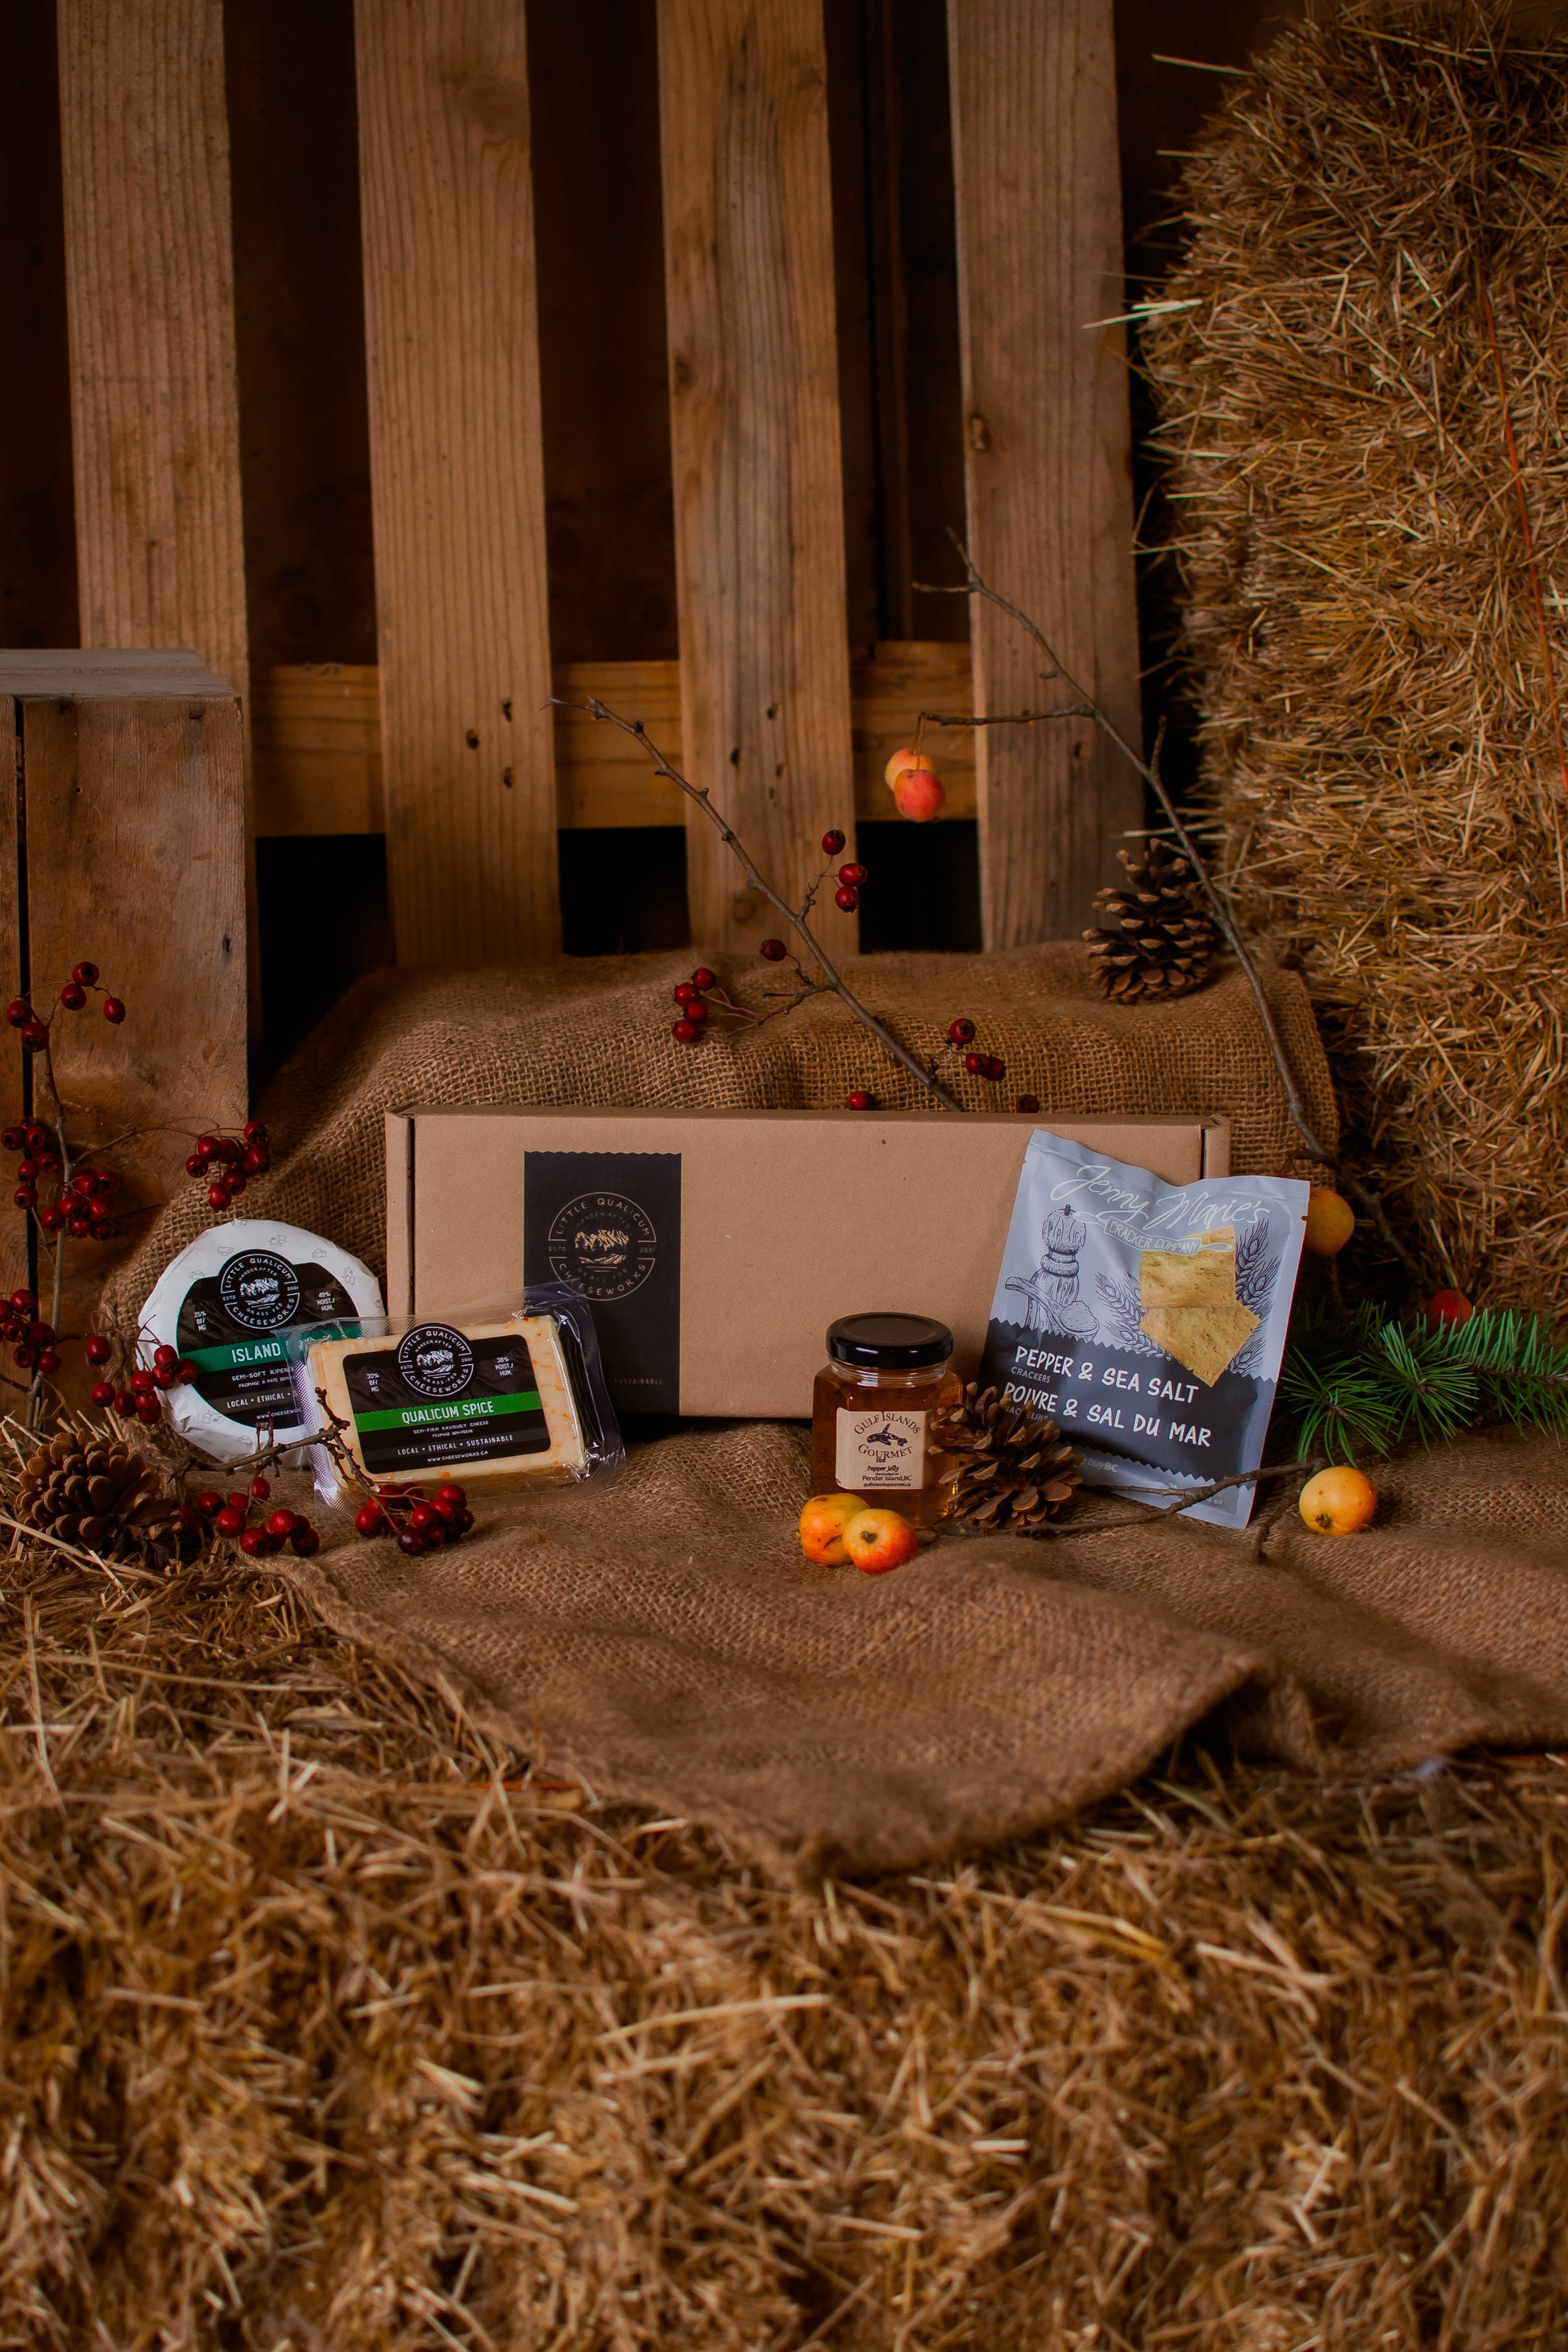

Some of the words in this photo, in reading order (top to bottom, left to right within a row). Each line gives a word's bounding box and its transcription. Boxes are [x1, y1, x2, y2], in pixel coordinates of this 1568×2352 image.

[1050, 1164, 1149, 1223] Jenny
[1143, 1192, 1271, 1231] Marie's
[555, 1201, 587, 1235] LITTLE
[597, 1197, 650, 1235] QUALICUM
[1108, 1222, 1152, 1249] CRACKER
[1155, 1238, 1199, 1254] COMPANY
[225, 1262, 245, 1288] LITTLE
[249, 1257, 292, 1280] QUALICUM
[558, 1263, 646, 1296] CHEESEWORKS
[232, 1297, 296, 1326] CHEESEWORKS
[231, 1342, 281, 1363] ISLAND
[402, 1334, 421, 1359] LITTLE
[425, 1330, 467, 1352] QUALICUM
[414, 1339, 452, 1353] HANDCRAFTED
[231, 1370, 267, 1382] SEMI-SOFT
[409, 1368, 469, 1393] CHEESEWORKS
[422, 1371, 458, 1384] GRASS-FED
[1010, 1366, 1052, 1384] CRACKERS
[1014, 1346, 1074, 1378] PEPPER
[1077, 1362, 1094, 1381] &
[1101, 1367, 1140, 1392] SEA
[1147, 1377, 1199, 1404] SALT
[226, 1398, 249, 1409] LOCAL
[256, 1392, 285, 1403] ETHICAL
[401, 1405, 459, 1425] QUALICUM
[462, 1400, 495, 1417] SPICE
[999, 1381, 1059, 1413] POIVRE
[1062, 1398, 1078, 1418] &
[1086, 1404, 1125, 1429] SAL
[1133, 1413, 1160, 1437] DU
[1168, 1421, 1212, 1448] MAR
[413, 1426, 440, 1434] SEMI-FIRM
[442, 1423, 467, 1431] SAVOURY
[470, 1420, 490, 1428] CHEESE
[854, 1414, 880, 1434] GULF
[397, 1446, 420, 1456] LOCAL
[428, 1442, 458, 1452] ETHICAL
[466, 1434, 514, 1447] SUSTAINABLE
[426, 1450, 489, 1462] WWW.CHEESEWORKS.CA
[866, 1465, 887, 1473] Pepper
[886, 1464, 900, 1473] Jelly
[1088, 1456, 1119, 1474] buyBC
